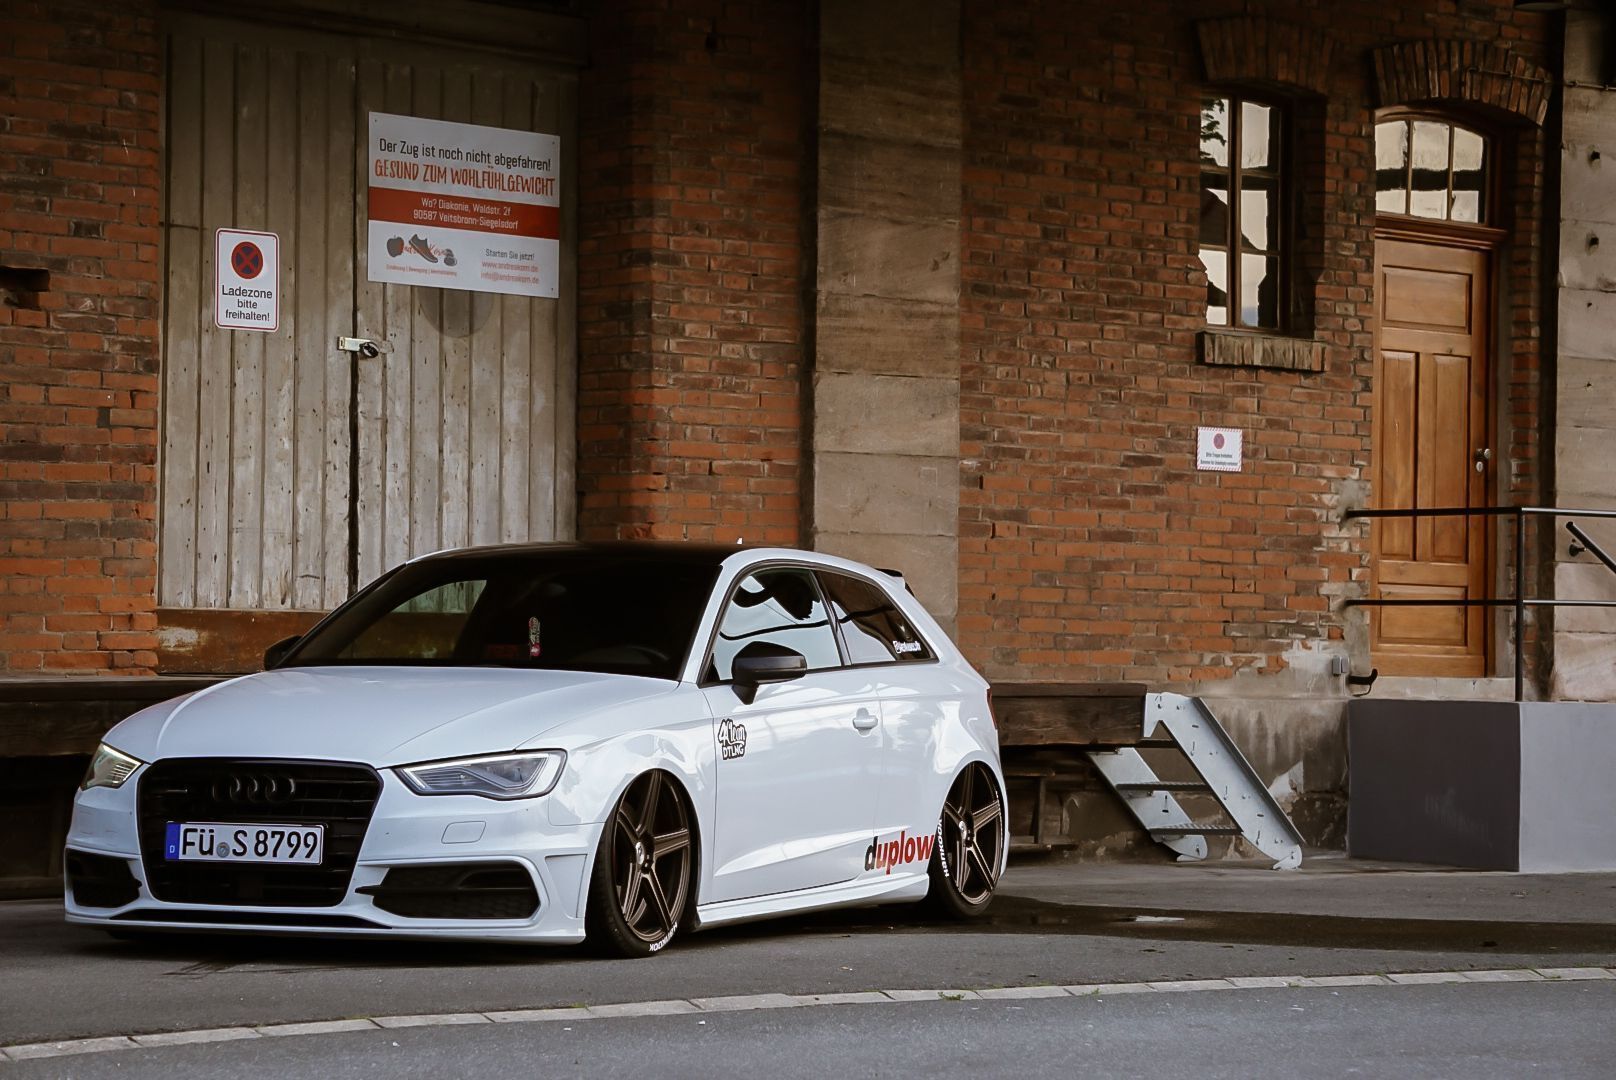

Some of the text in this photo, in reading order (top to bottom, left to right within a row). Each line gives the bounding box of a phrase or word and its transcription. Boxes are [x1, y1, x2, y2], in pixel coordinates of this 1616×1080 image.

[379, 137, 552, 172] Der Zug ist noch nicht abgefahren!
[374, 158, 556, 197] GESUND ZUM WOHLFÜHLGEWICHT
[421, 197, 437, 208] Wo?
[413, 208, 438, 221] 90587
[485, 248, 508, 260] Starten
[508, 250, 519, 260] Sie
[221, 284, 273, 300] Ladezone
[237, 298, 258, 309] bitte
[225, 308, 270, 322] freihalten!
[182, 827, 215, 856] FÜ
[232, 829, 248, 857] S
[254, 829, 318, 859] 8799
[864, 830, 935, 876] duplow
